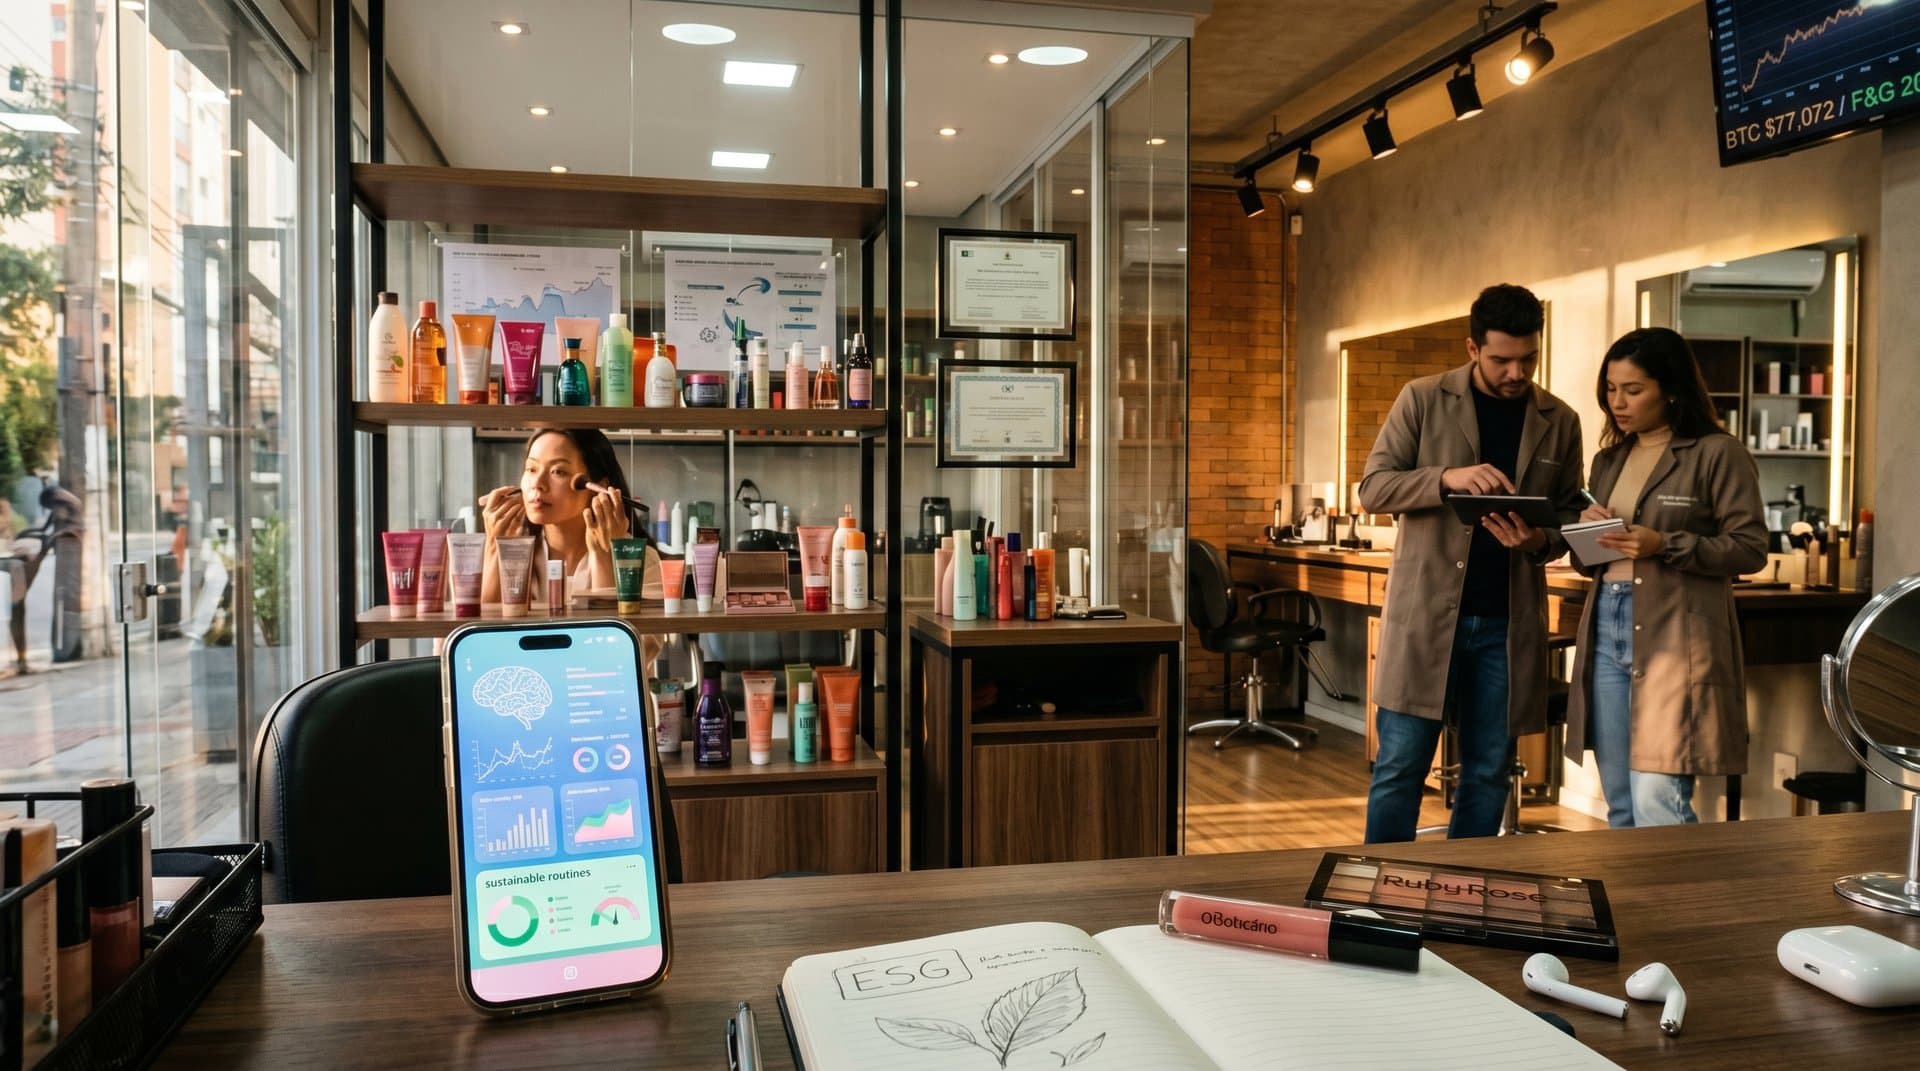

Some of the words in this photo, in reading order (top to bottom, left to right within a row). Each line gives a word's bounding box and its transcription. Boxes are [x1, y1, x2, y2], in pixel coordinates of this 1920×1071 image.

[1726, 123, 1761, 149] BTC
[1765, 100, 1835, 139] $77,072
[1851, 81, 1895, 112] F&G
[485, 873, 546, 888] sustainable
[548, 869, 591, 881] routines
[1383, 874, 1461, 896] Ruby
[1467, 884, 1548, 903] Rose
[852, 959, 950, 992] ESG
